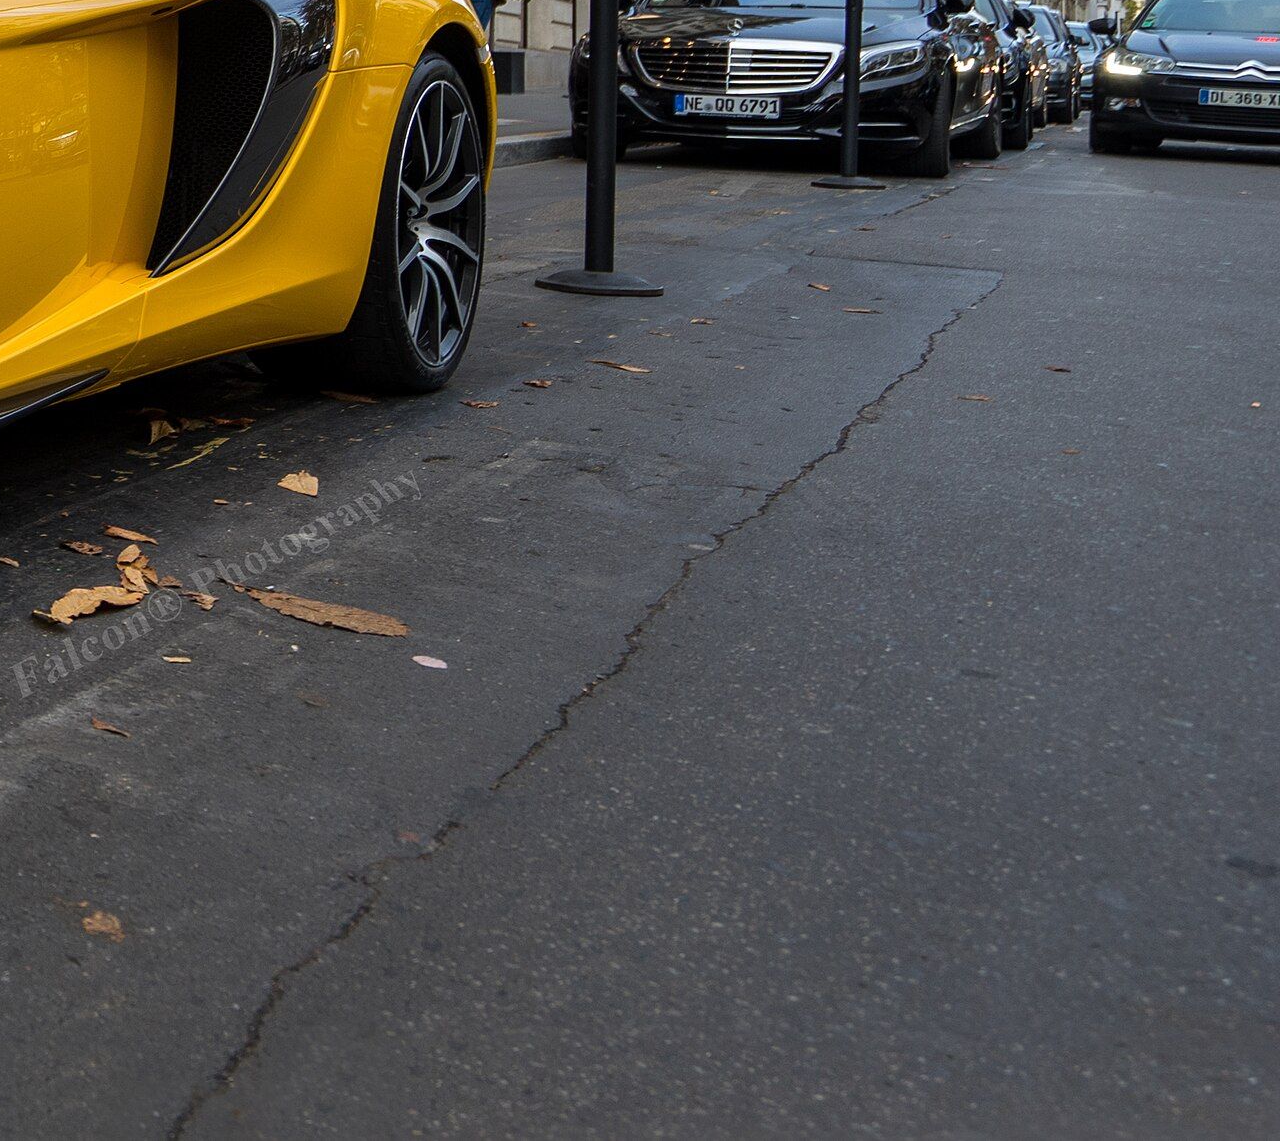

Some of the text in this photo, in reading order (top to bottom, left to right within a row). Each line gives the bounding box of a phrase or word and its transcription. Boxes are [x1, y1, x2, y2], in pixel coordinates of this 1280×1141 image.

[685, 97, 778, 114] NE QQ 6791
